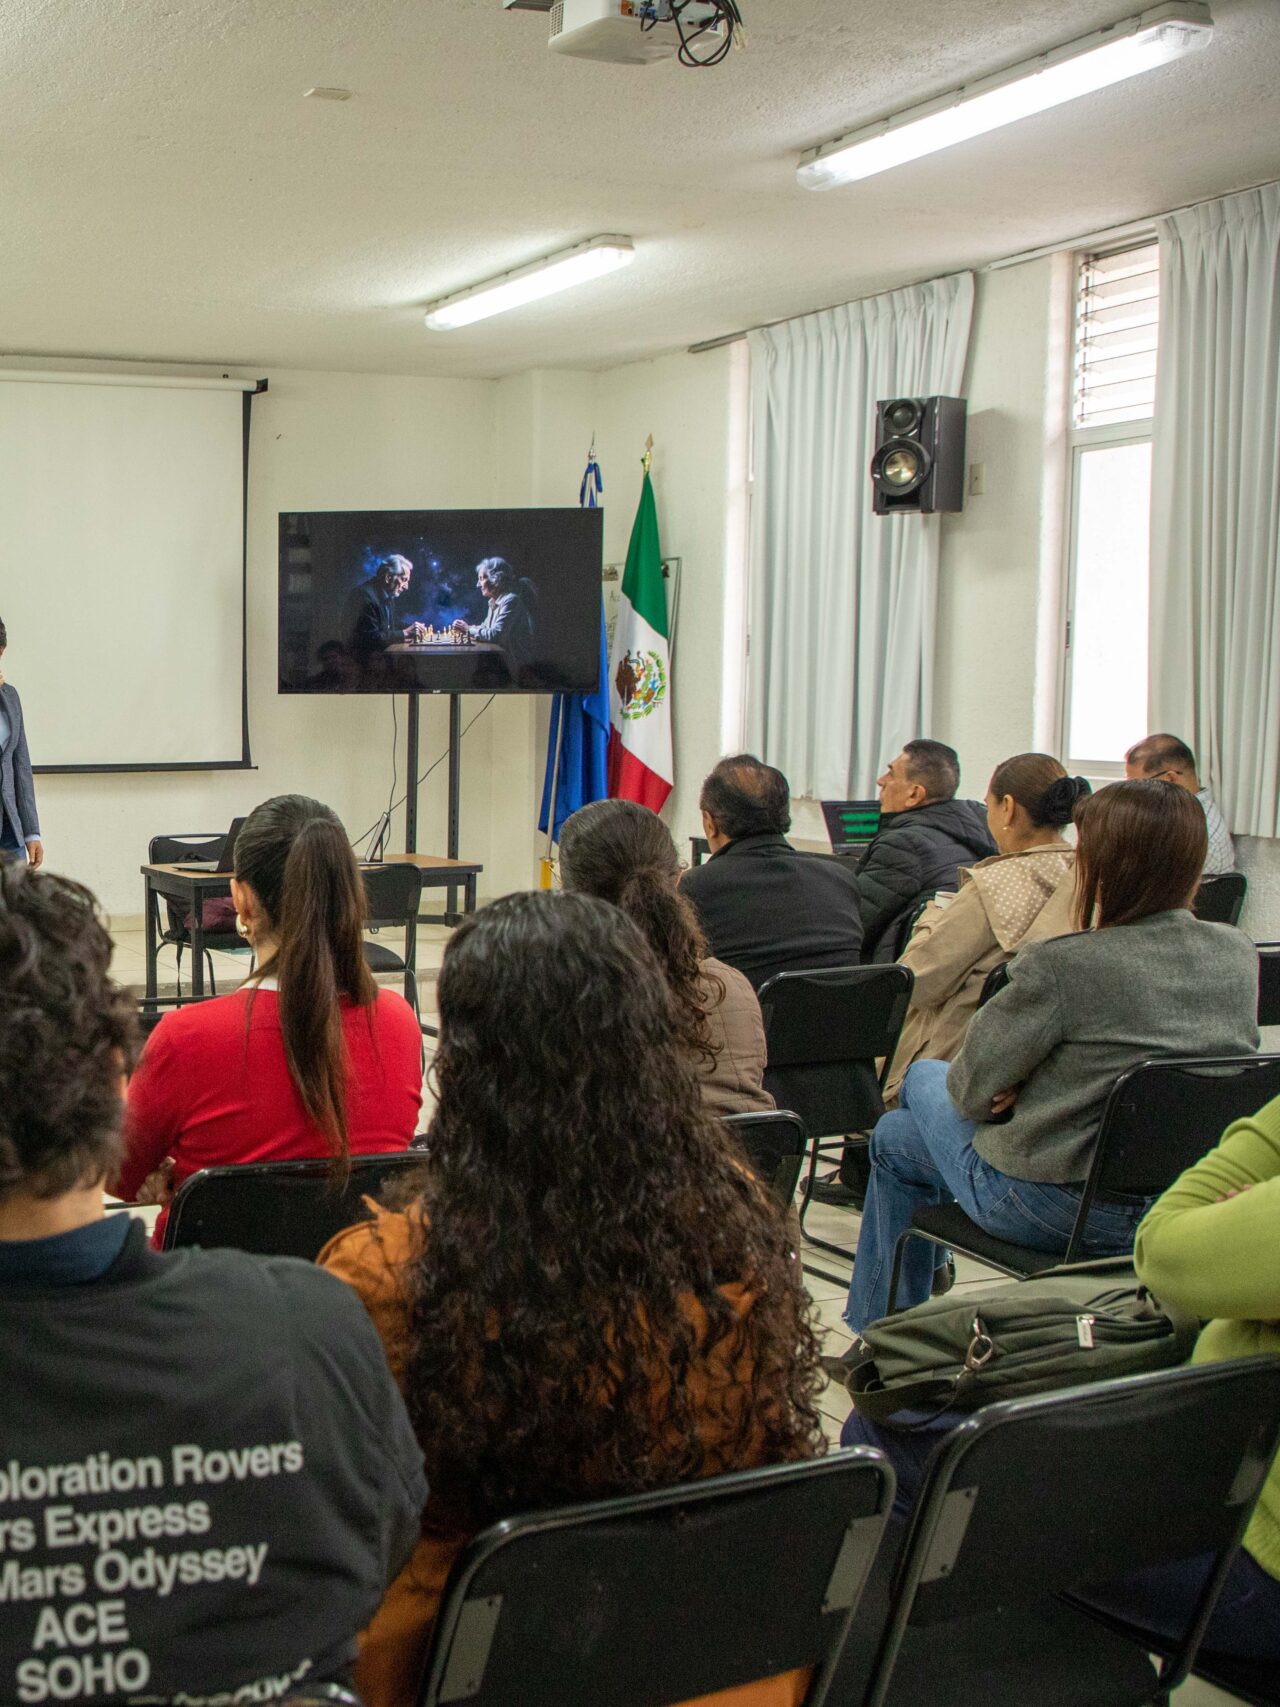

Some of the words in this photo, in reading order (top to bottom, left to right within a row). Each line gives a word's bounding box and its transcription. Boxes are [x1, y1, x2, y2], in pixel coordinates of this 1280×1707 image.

[171, 1440, 304, 1485] Rovers
[44, 1500, 211, 1550] Express
[94, 1543, 269, 1596] Odyssey
[32, 1601, 129, 1650] ACE
[15, 1649, 150, 1702] SOHO
